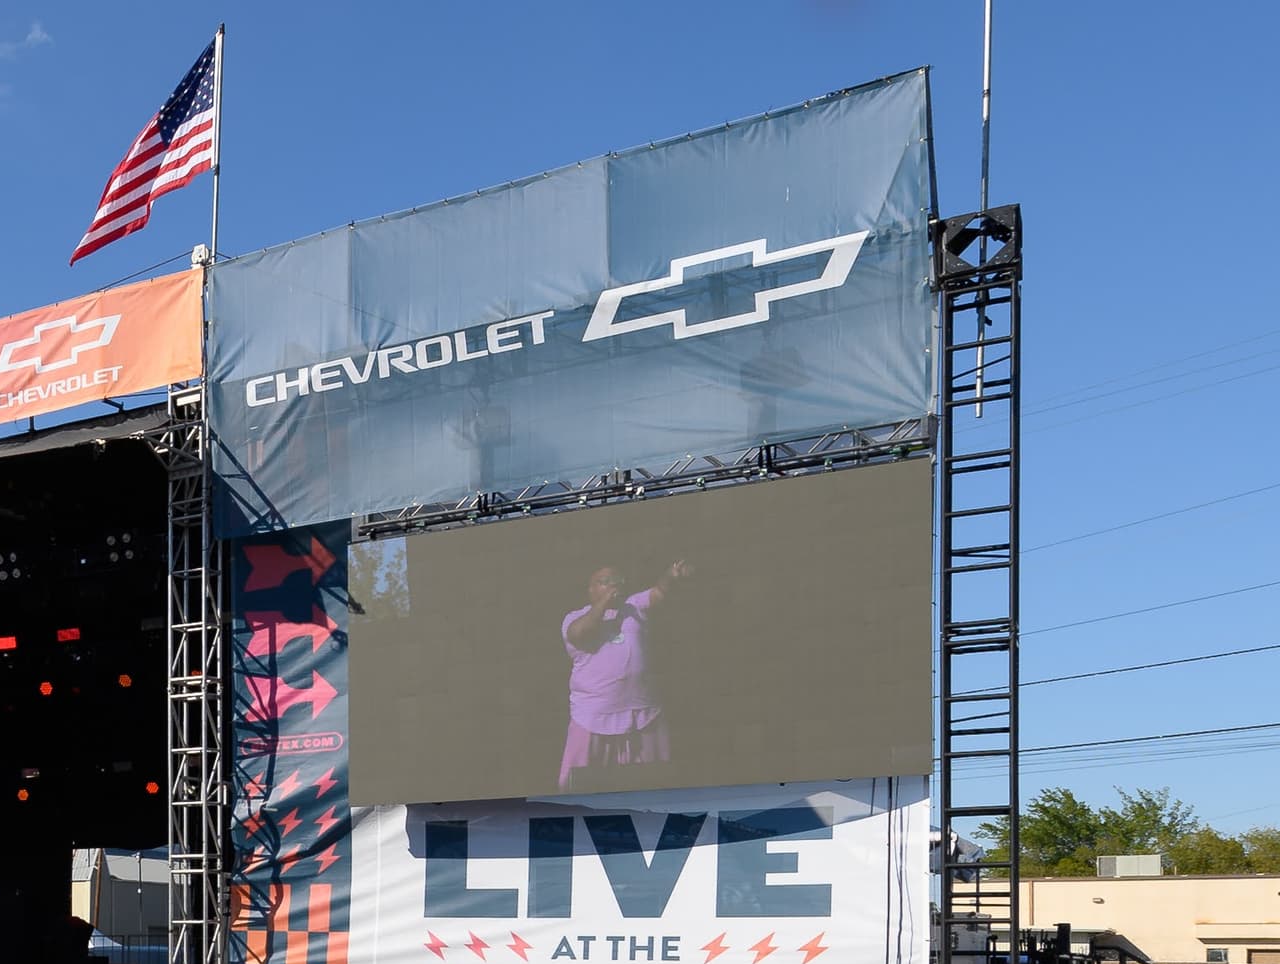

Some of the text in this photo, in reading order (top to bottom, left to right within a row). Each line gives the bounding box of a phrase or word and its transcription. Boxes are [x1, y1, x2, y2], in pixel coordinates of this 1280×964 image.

[245, 309, 555, 408] CHEVROLET
[423, 805, 835, 919] LIVE
[550, 934, 682, 962] AT THE
